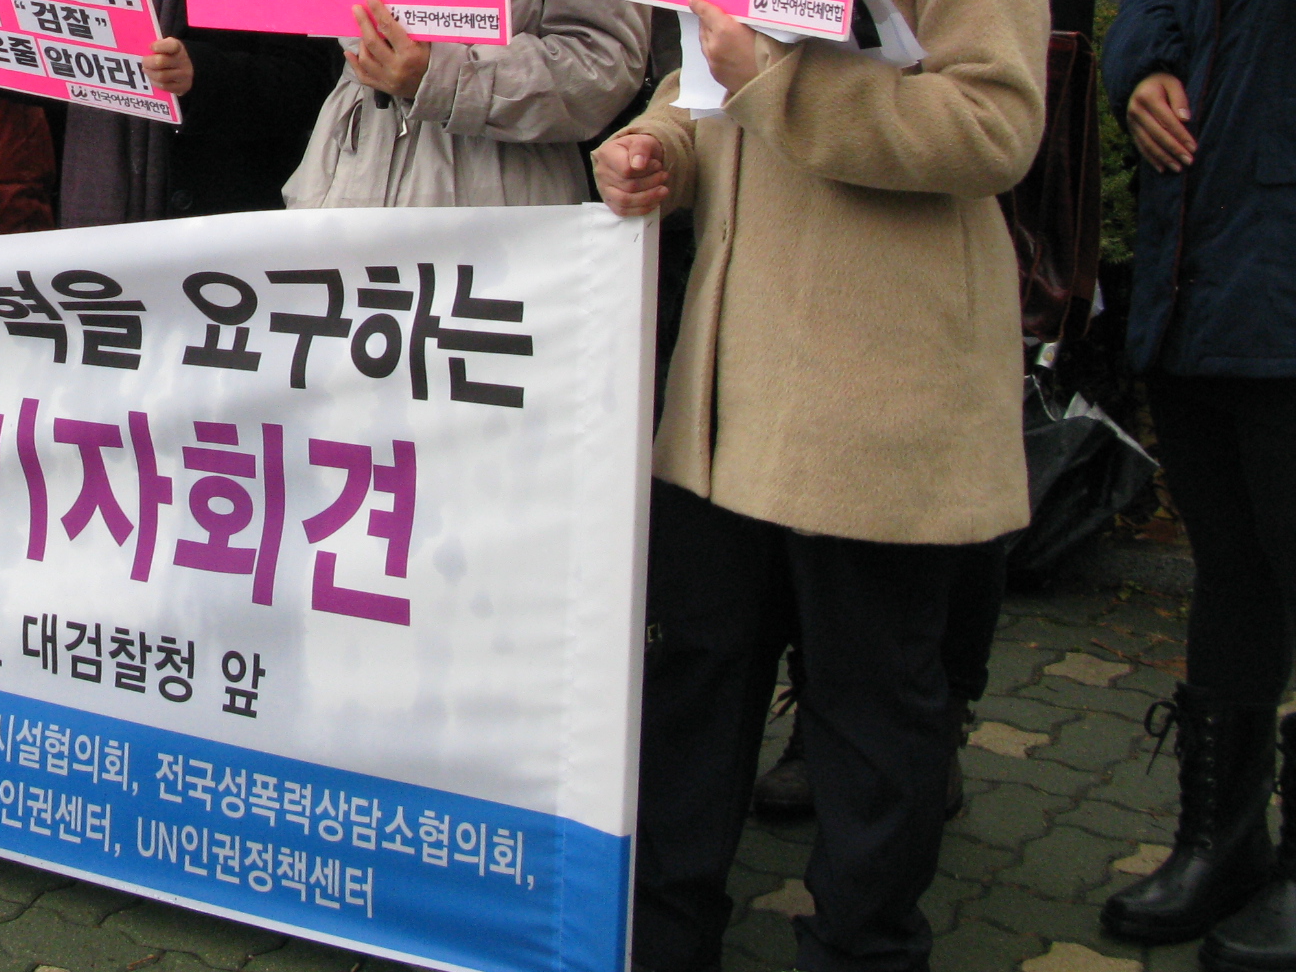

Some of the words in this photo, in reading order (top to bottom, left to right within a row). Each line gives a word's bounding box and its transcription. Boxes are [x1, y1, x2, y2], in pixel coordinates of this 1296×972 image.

[44, 45, 150, 93] 알아라!
[404, 9, 500, 30] 한국여성단체연합
[90, 89, 170, 116] 한국여성단체연합
[182, 262, 533, 409] 요구하는
[23, 613, 194, 703] 대검찰청
[221, 650, 266, 718] 앞
[137, 816, 373, 918] UN인권정책센터
[155, 751, 535, 891] 전국성폭력상담소협의회,
